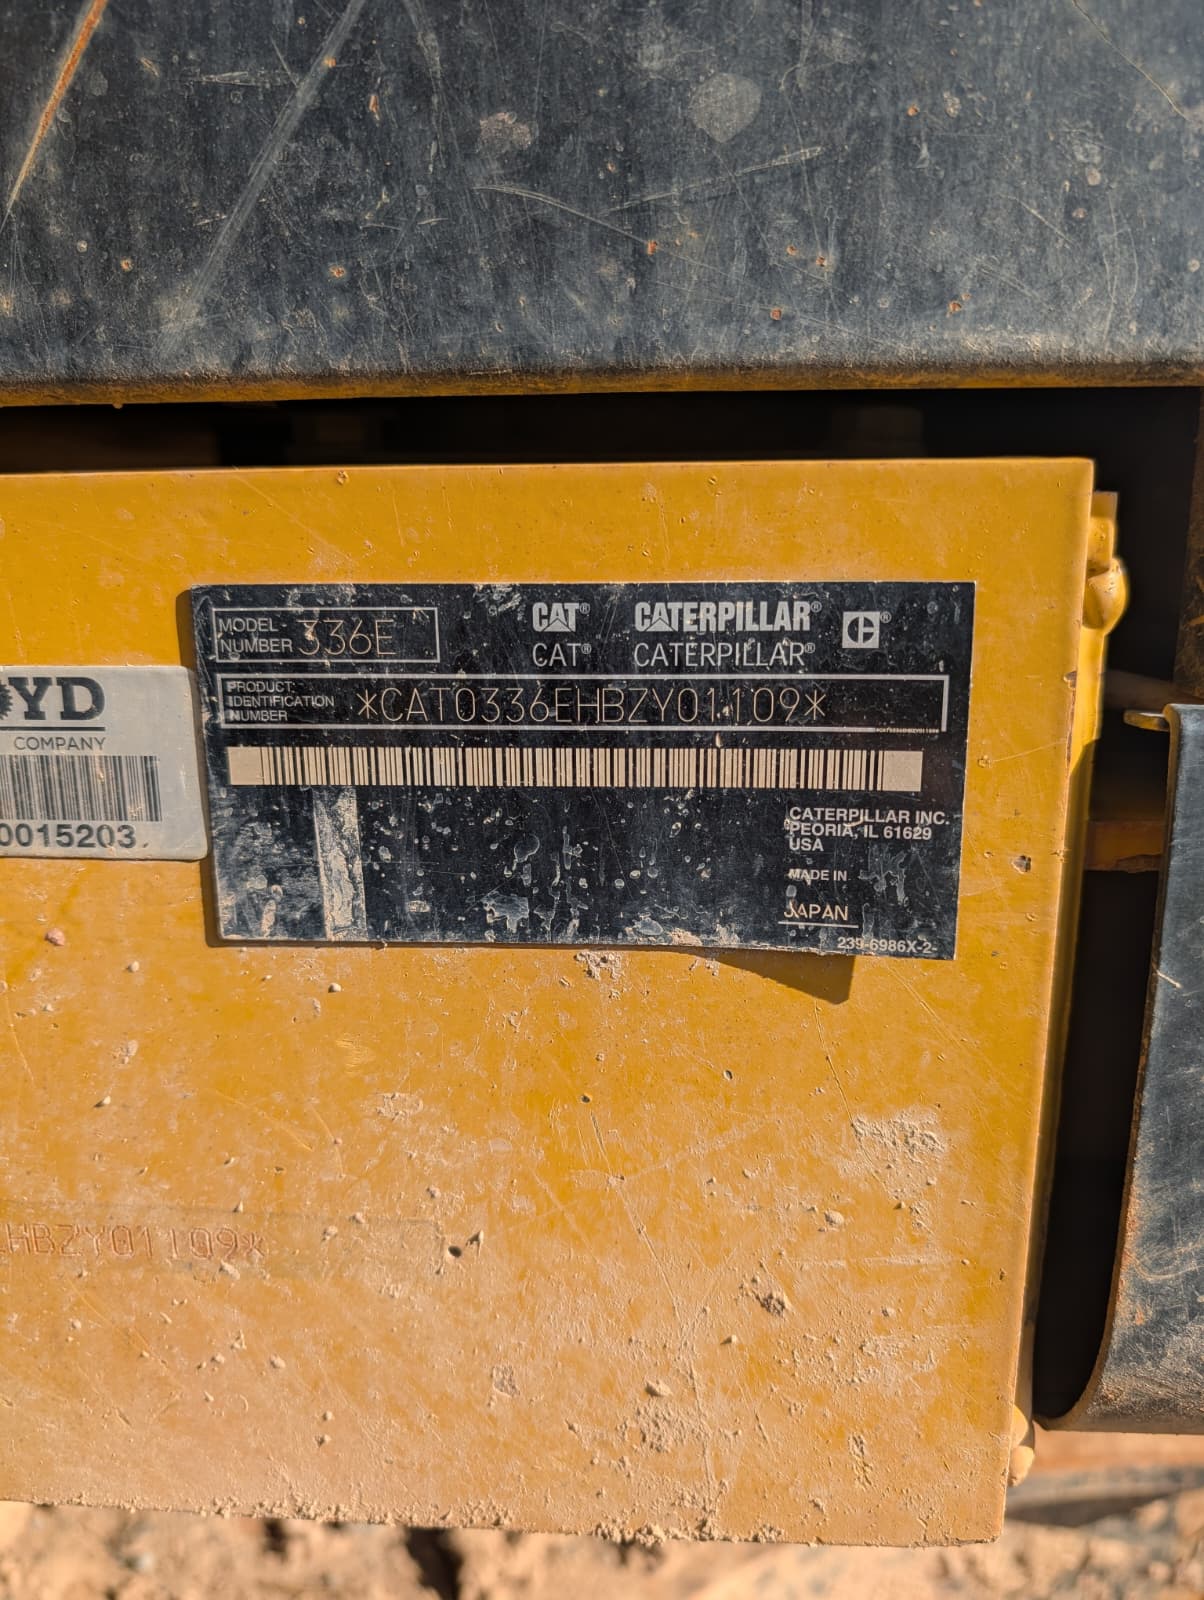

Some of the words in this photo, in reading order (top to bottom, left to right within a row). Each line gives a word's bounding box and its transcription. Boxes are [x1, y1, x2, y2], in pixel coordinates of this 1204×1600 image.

[218, 617, 279, 632] MODEL
[296, 618, 397, 656] 336E
[220, 638, 293, 653] NUMBER
[226, 681, 294, 693] PRODUCT
[0, 676, 105, 721] YD
[228, 695, 335, 708] IDENTIFICATION
[229, 709, 288, 722] NUMBER
[14, 736, 106, 751] COMPANY
[789, 806, 910, 825] CATERPILLAR
[915, 811, 950, 826] INC.
[789, 822, 859, 839] PEORIA,
[864, 825, 879, 838] IL
[883, 827, 932, 841] 61629
[789, 838, 824, 852] USA
[789, 868, 830, 882] MADE
[833, 870, 848, 882] IN
[784, 904, 849, 921] JAPAN
[0, 1223, 265, 1260] HBZY01109
